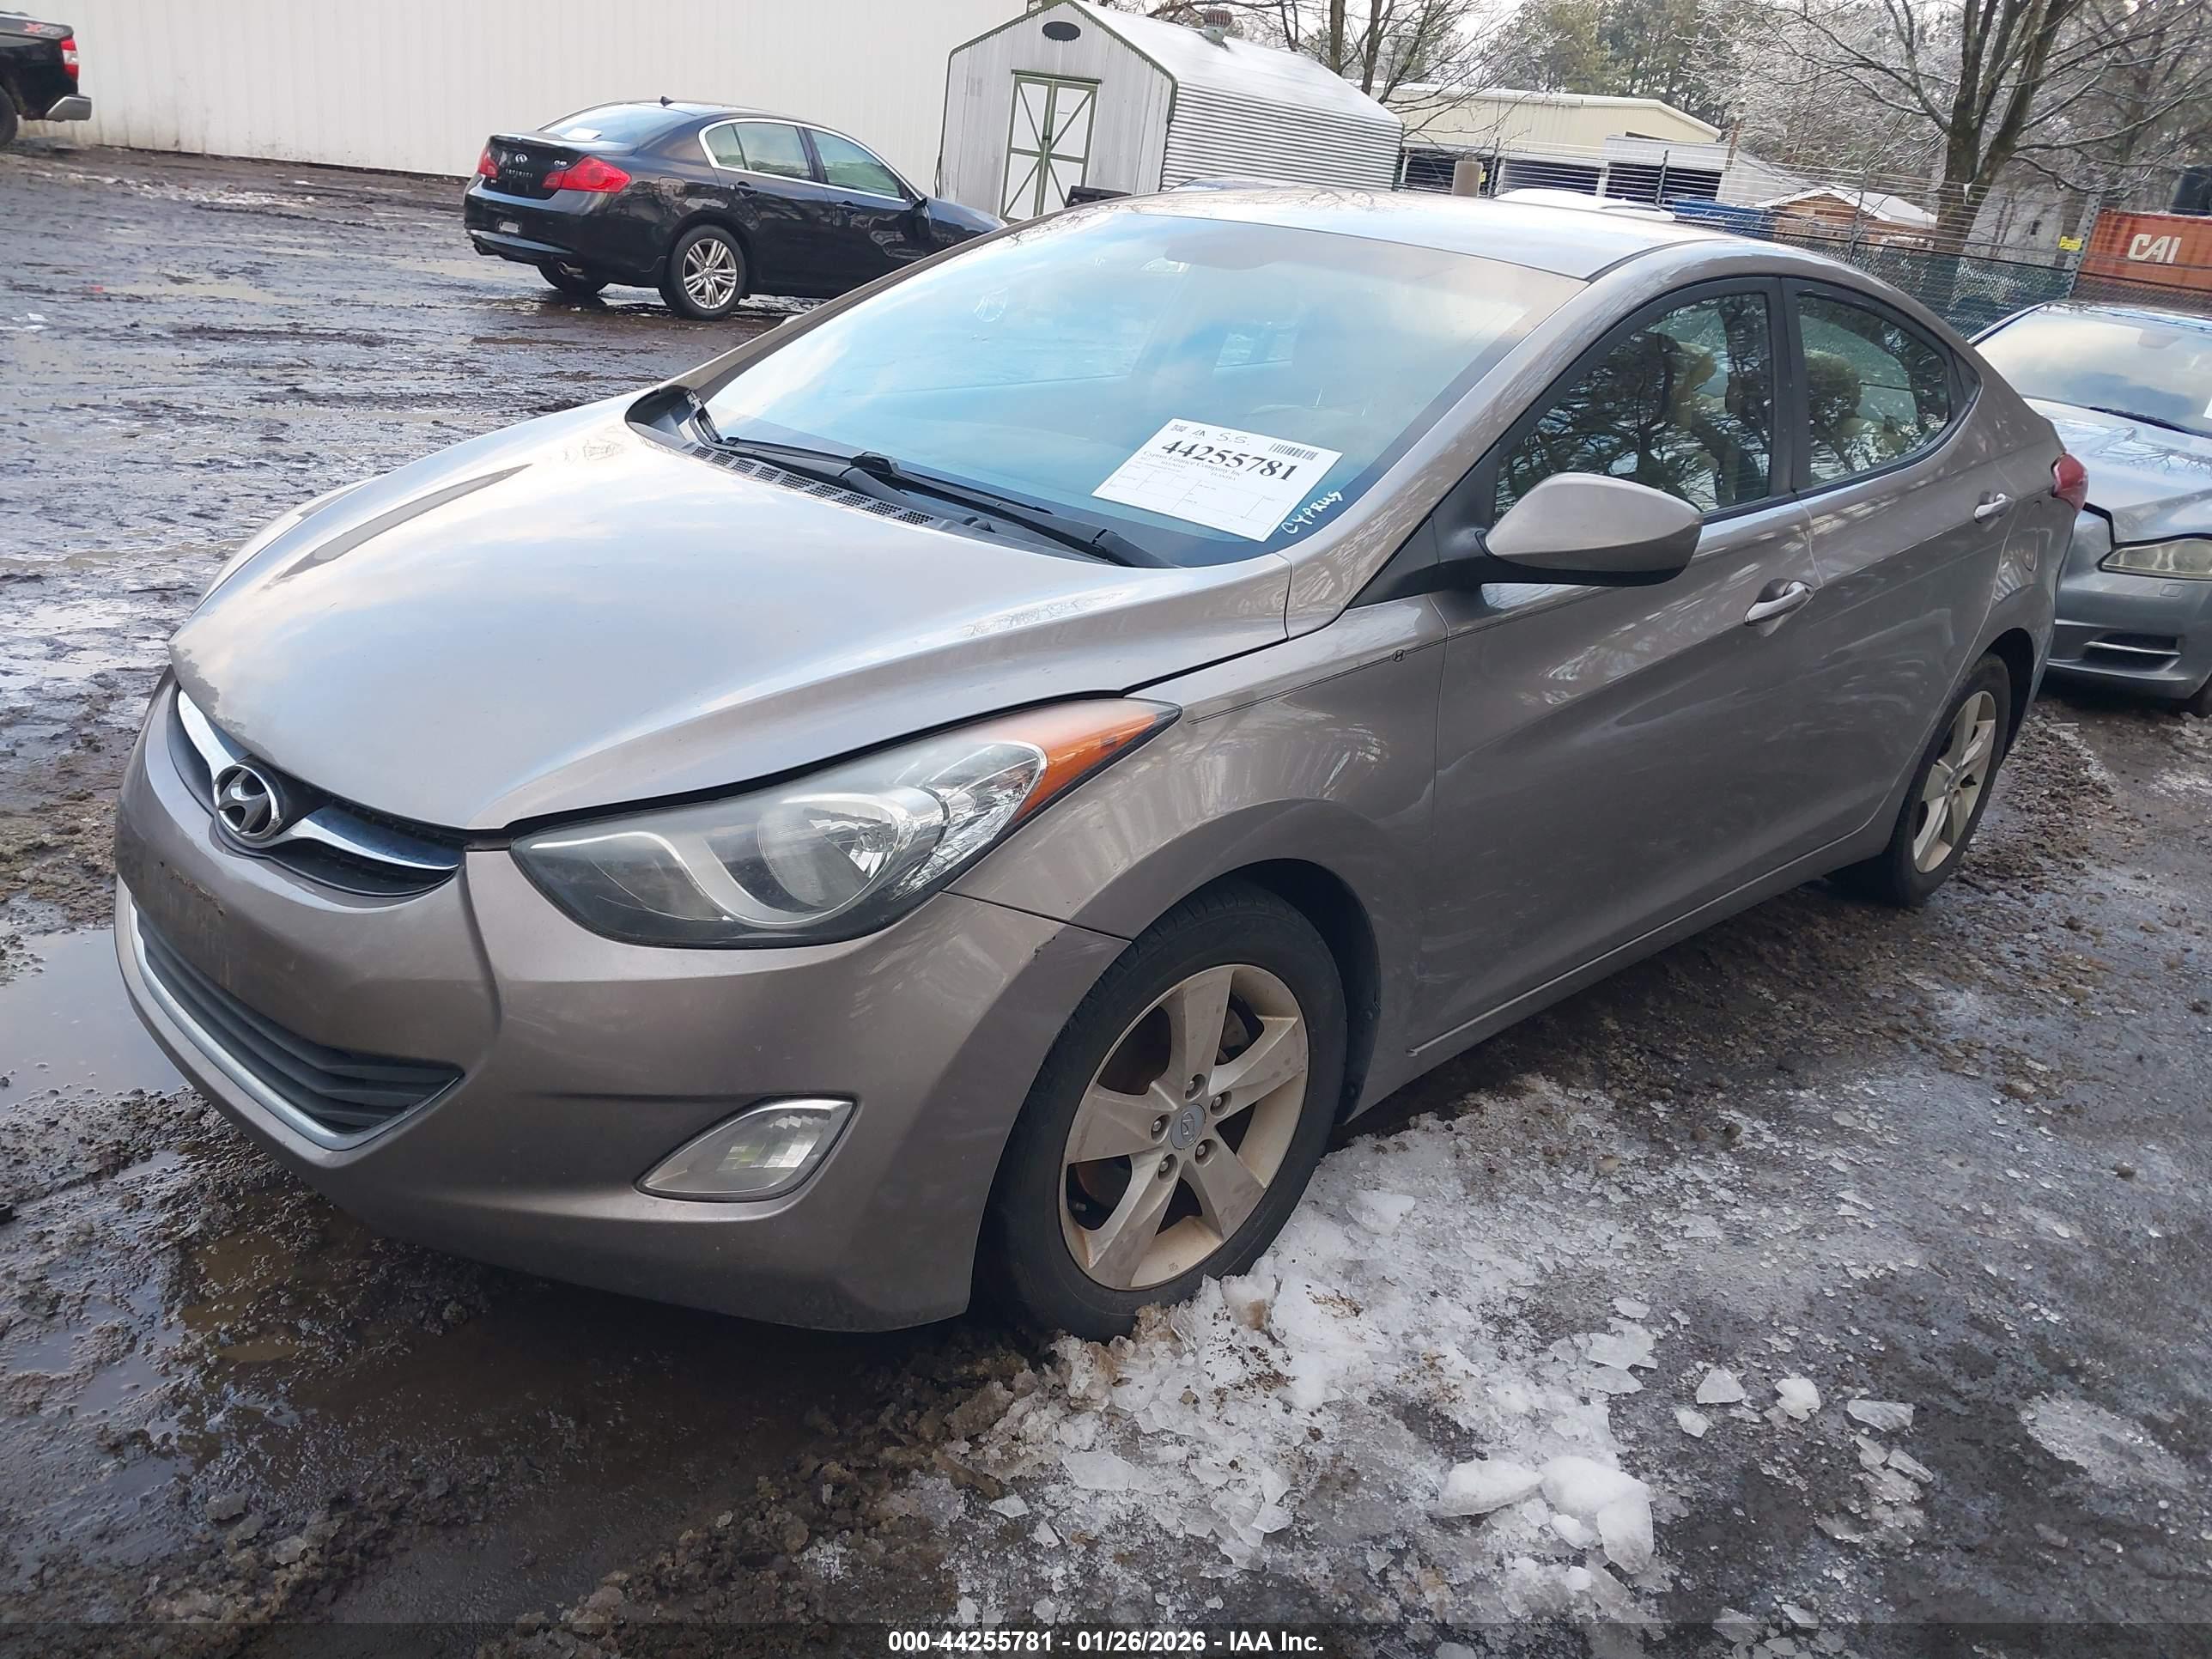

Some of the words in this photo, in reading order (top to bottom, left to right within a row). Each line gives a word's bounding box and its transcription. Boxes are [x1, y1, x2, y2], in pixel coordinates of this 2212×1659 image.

[2128, 233, 2183, 264] CAI
[1161, 441, 1298, 481] 44255781
[1280, 490, 1344, 534] CYPRUS
